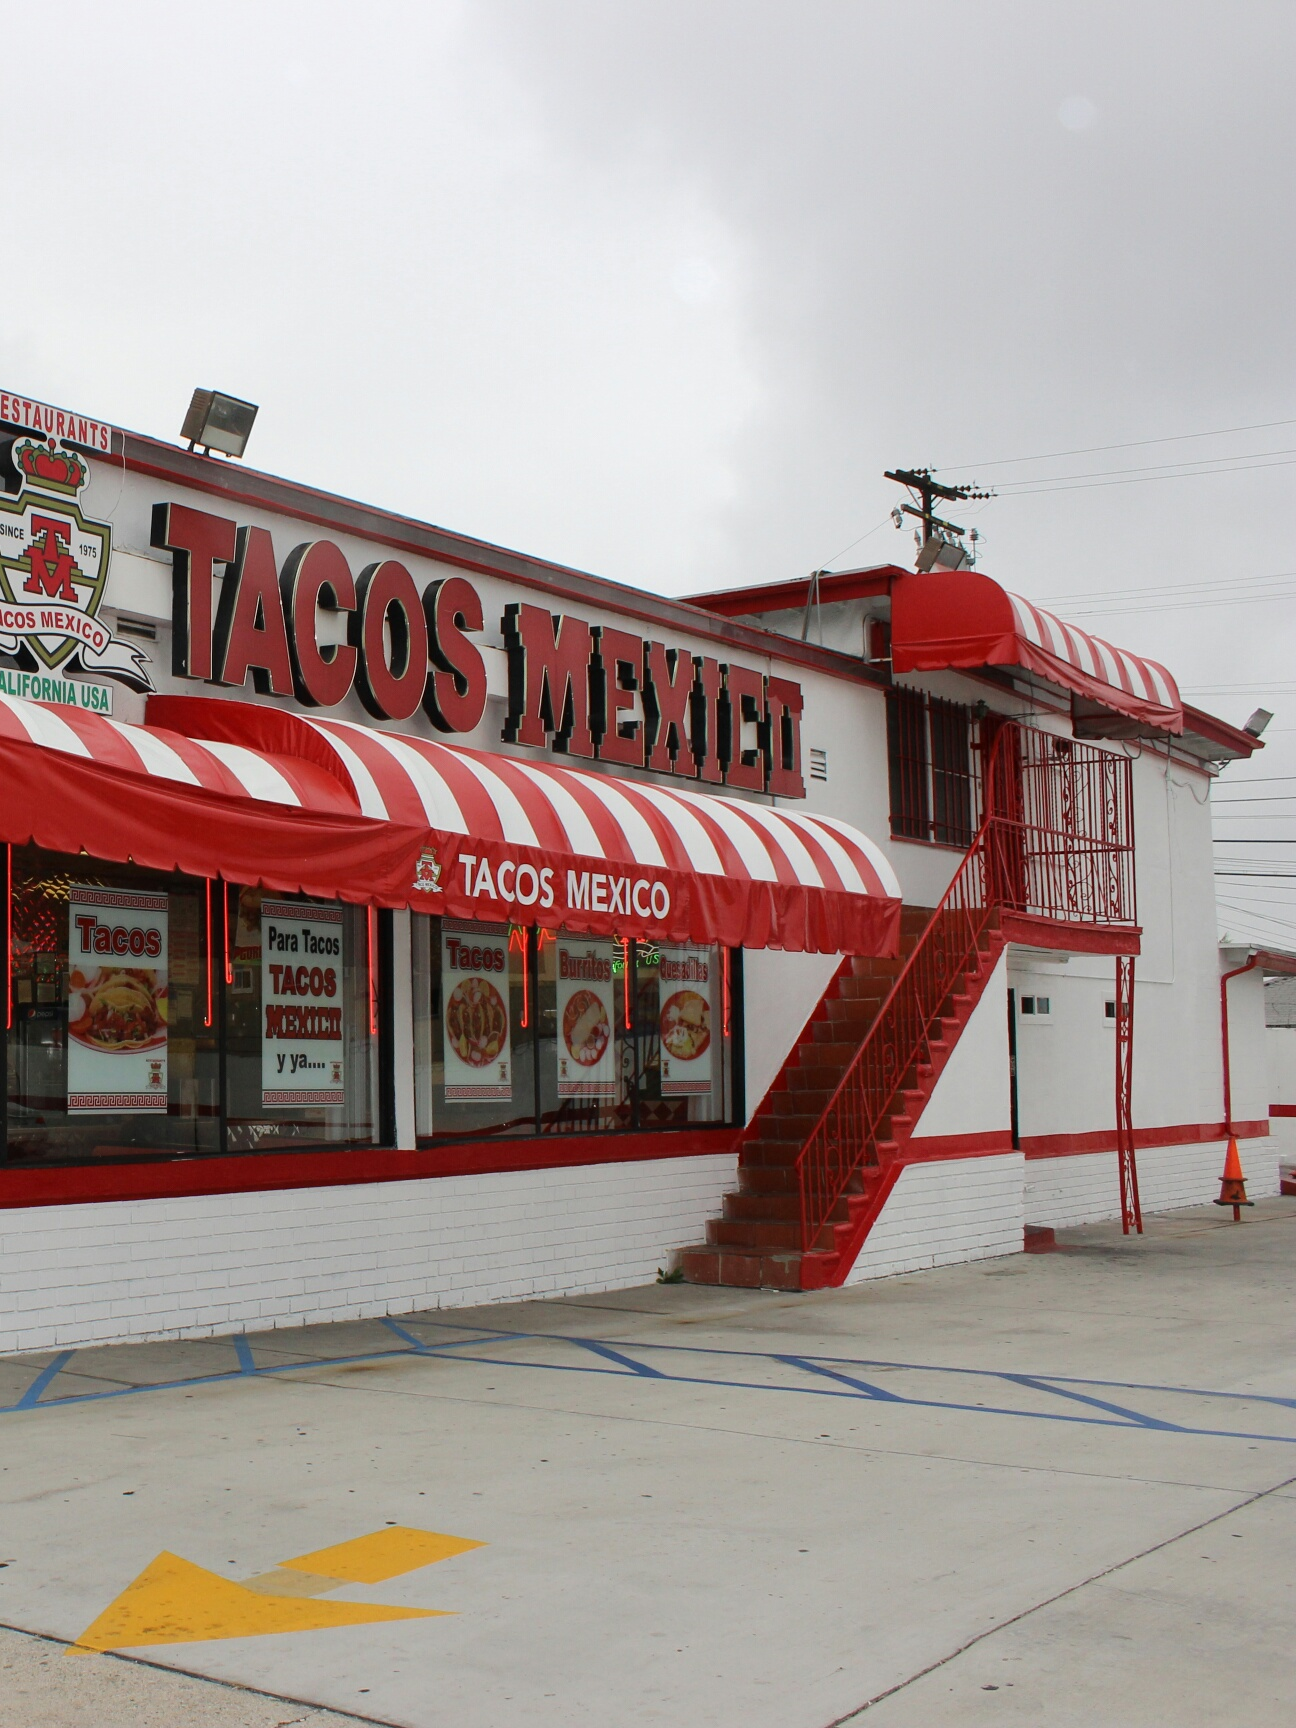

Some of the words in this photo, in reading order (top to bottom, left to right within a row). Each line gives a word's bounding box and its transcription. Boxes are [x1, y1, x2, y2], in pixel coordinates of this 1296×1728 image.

[0, 522, 25, 541] SINCE
[78, 543, 98, 559] 1975
[40, 610, 104, 648] MEXICO
[161, 502, 488, 733] TACOS
[505, 602, 807, 799] MEXICO
[80, 683, 110, 711] USA
[458, 853, 555, 909] TACOS
[567, 869, 671, 920] MEXICO
[75, 913, 162, 958] Tacos
[268, 926, 299, 951] Para
[302, 929, 340, 956] Tacos
[445, 937, 505, 973] Tacos
[559, 948, 613, 983] Burritos
[660, 953, 709, 984] Quesadillas
[269, 964, 338, 998] TACOS
[266, 1004, 342, 1041] MEXICO
[277, 1052, 287, 1074] y
